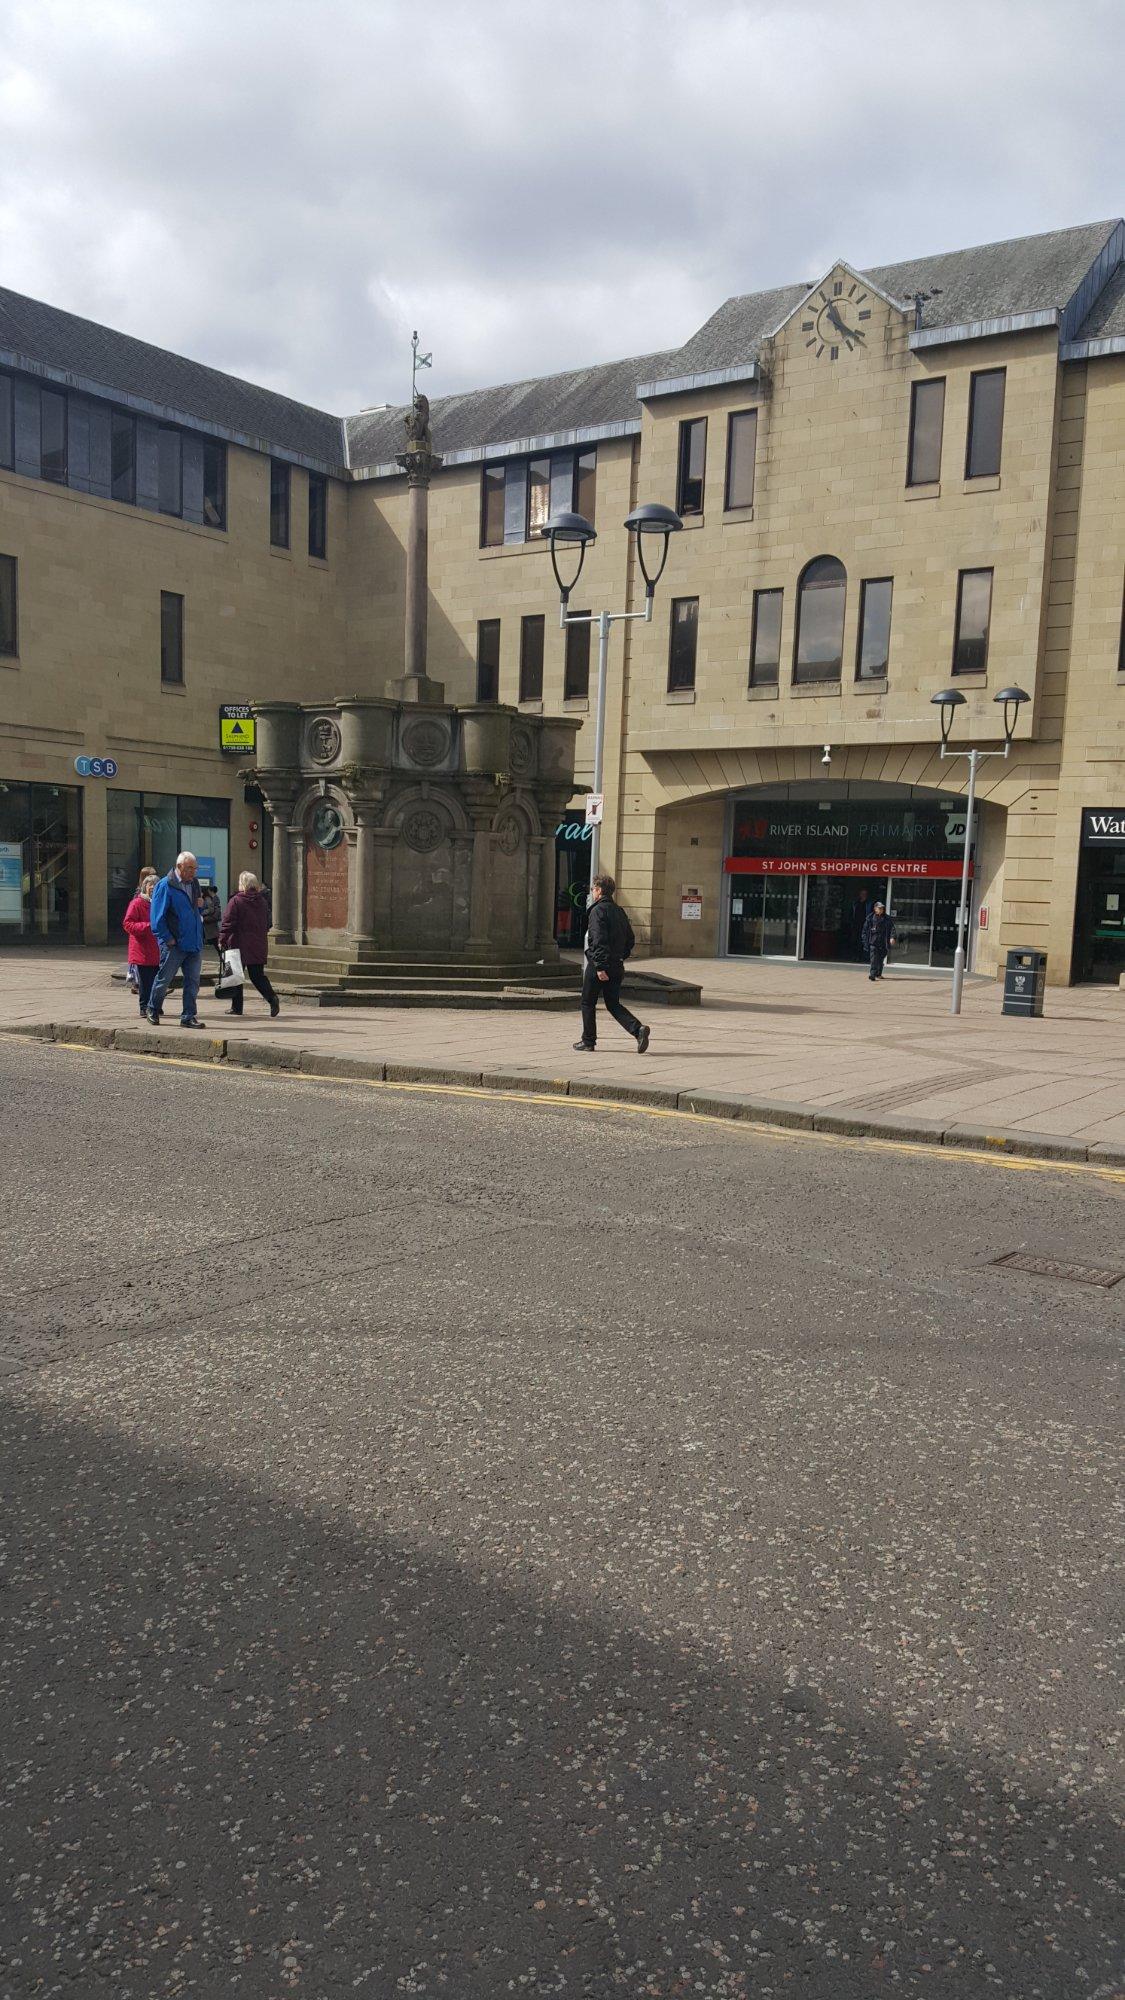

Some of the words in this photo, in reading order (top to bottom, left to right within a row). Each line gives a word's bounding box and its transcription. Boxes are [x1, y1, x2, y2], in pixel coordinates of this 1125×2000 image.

[79, 759, 115, 775] TSB
[770, 824, 801, 836] RIVER
[807, 824, 849, 836] ISLAND
[859, 824, 936, 837] PRIMARK
[948, 823, 967, 836] JD
[762, 861, 773, 870] ST
[778, 861, 817, 871] JOHN'S
[821, 862, 878, 872] SHOPPING
[882, 863, 928, 873] CENTRE
